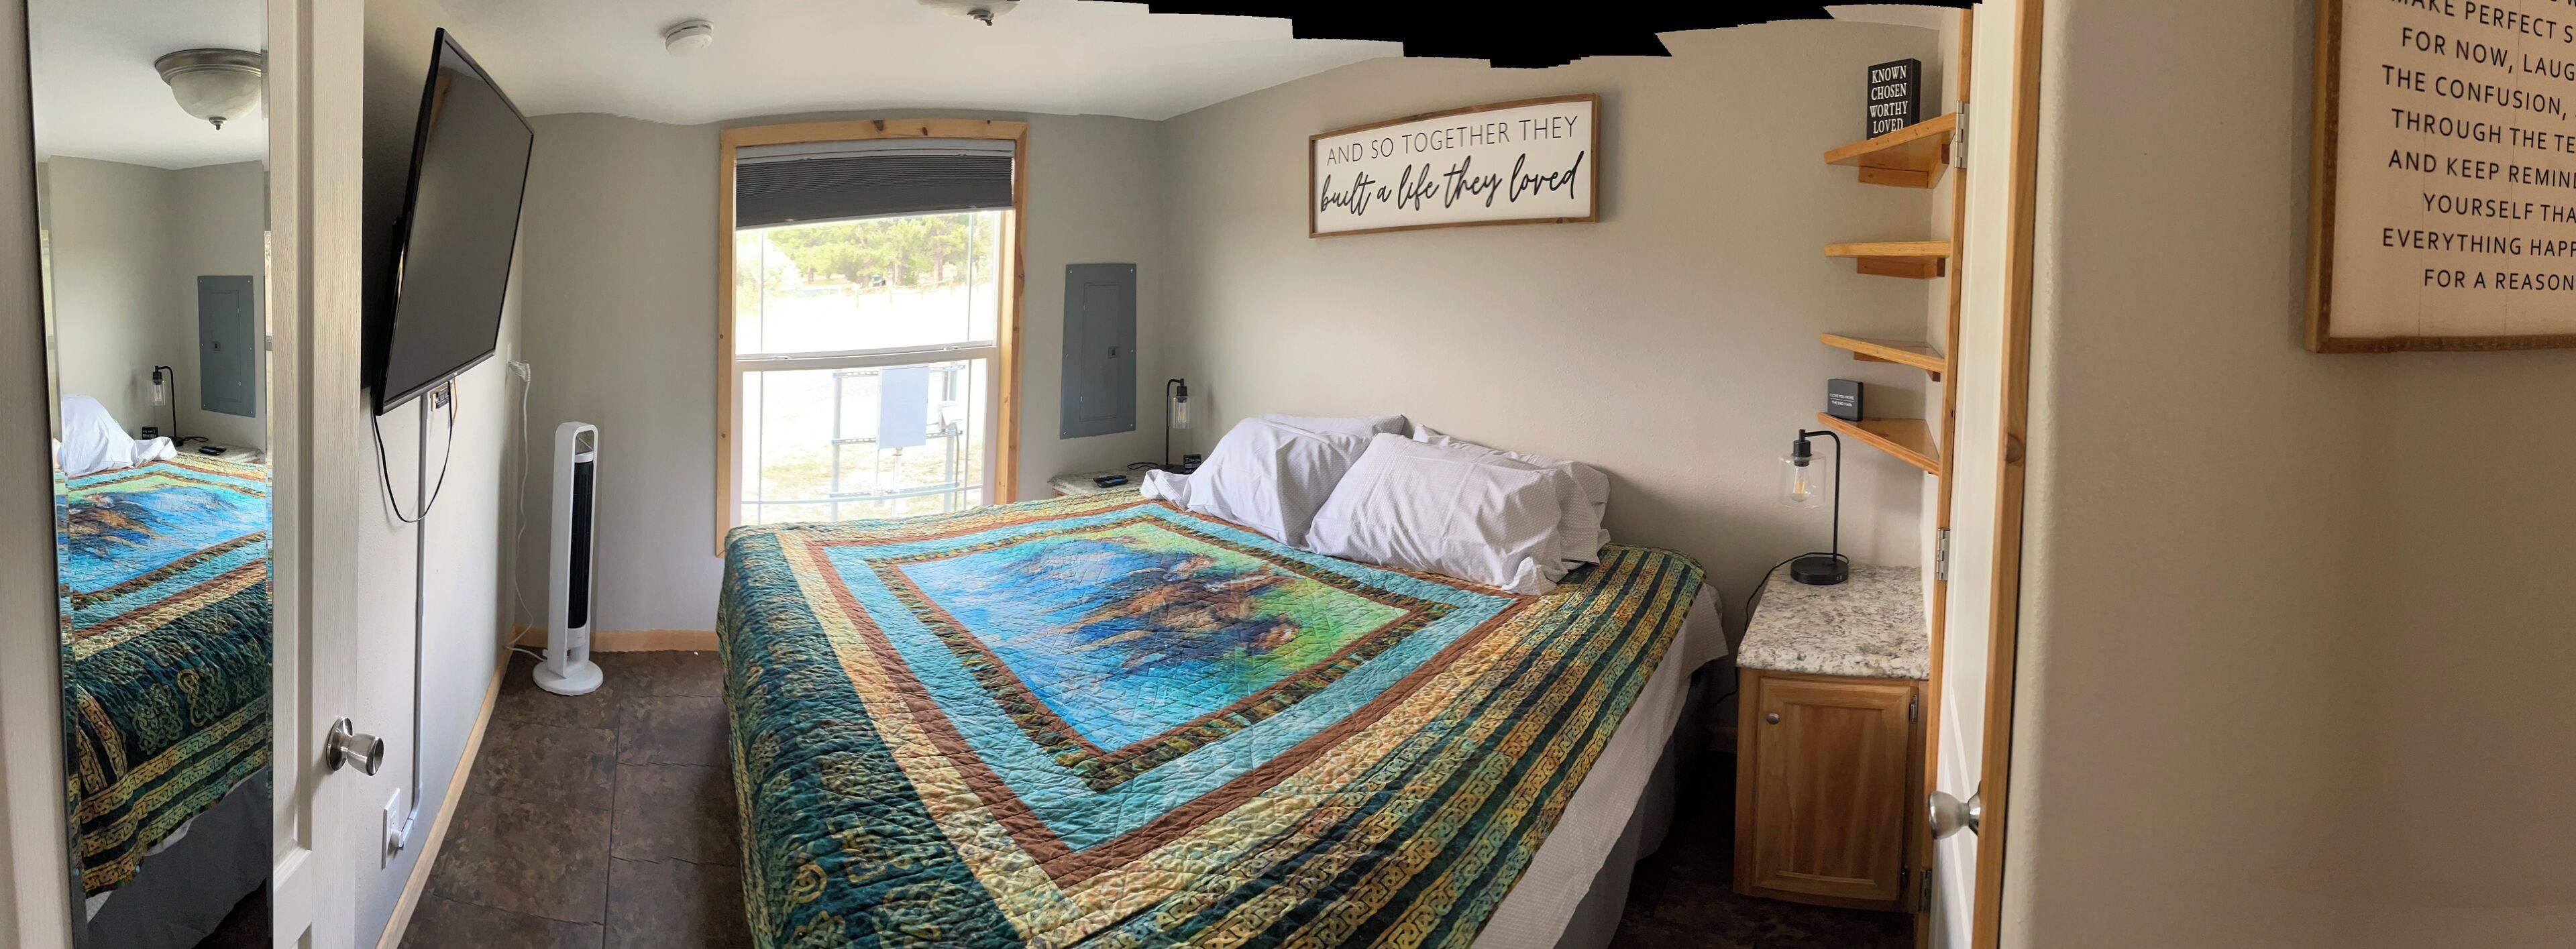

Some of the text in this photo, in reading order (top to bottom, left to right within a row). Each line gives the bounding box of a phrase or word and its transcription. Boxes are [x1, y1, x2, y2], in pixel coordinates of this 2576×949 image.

[2391, 0, 2573, 44] AKE PERFECT S
[2402, 27, 2575, 81] FOR NOW, LAUG
[1872, 65, 1907, 84] KNOWN
[1871, 82, 1907, 101] CHOSEN
[2381, 64, 2567, 121] THE CONFUSION,
[1869, 101, 1909, 118] WORTHY
[1326, 115, 1578, 166] AND SO TOGETHER THEY
[1873, 117, 1904, 134] LOVED
[2392, 109, 2575, 154] THROUGH THE TE
[2388, 150, 2437, 173] AND
[2447, 157, 2500, 180] KEEP
[1320, 150, 1585, 217] built a life they loved
[2423, 192, 2576, 224] YOURSELF THA
[2383, 228, 2522, 256] EVERYTHING
[2424, 269, 2575, 291] FOR A REASON
